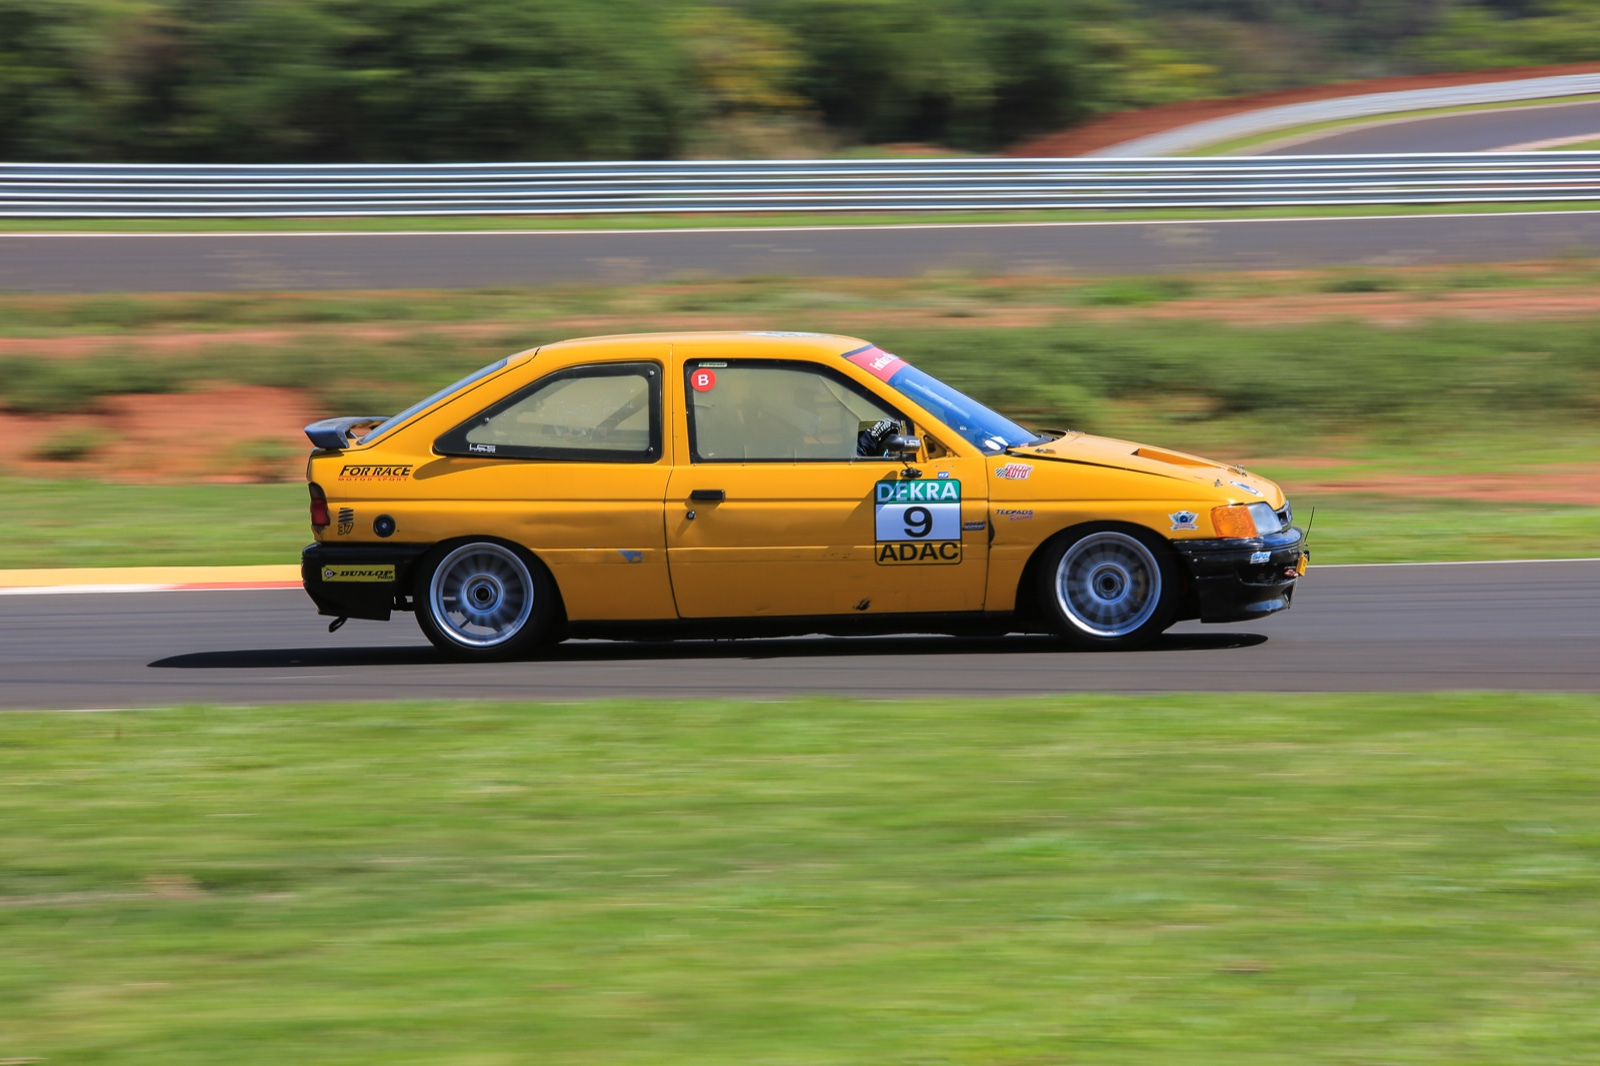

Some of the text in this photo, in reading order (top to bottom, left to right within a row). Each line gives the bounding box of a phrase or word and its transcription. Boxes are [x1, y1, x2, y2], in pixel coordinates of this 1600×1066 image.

[698, 374, 709, 386] B
[340, 465, 411, 476] FOR RACE
[1005, 469, 1028, 478] AUTO
[877, 482, 958, 502] DEKRA
[903, 506, 933, 538] 9
[879, 542, 959, 562] ADAC
